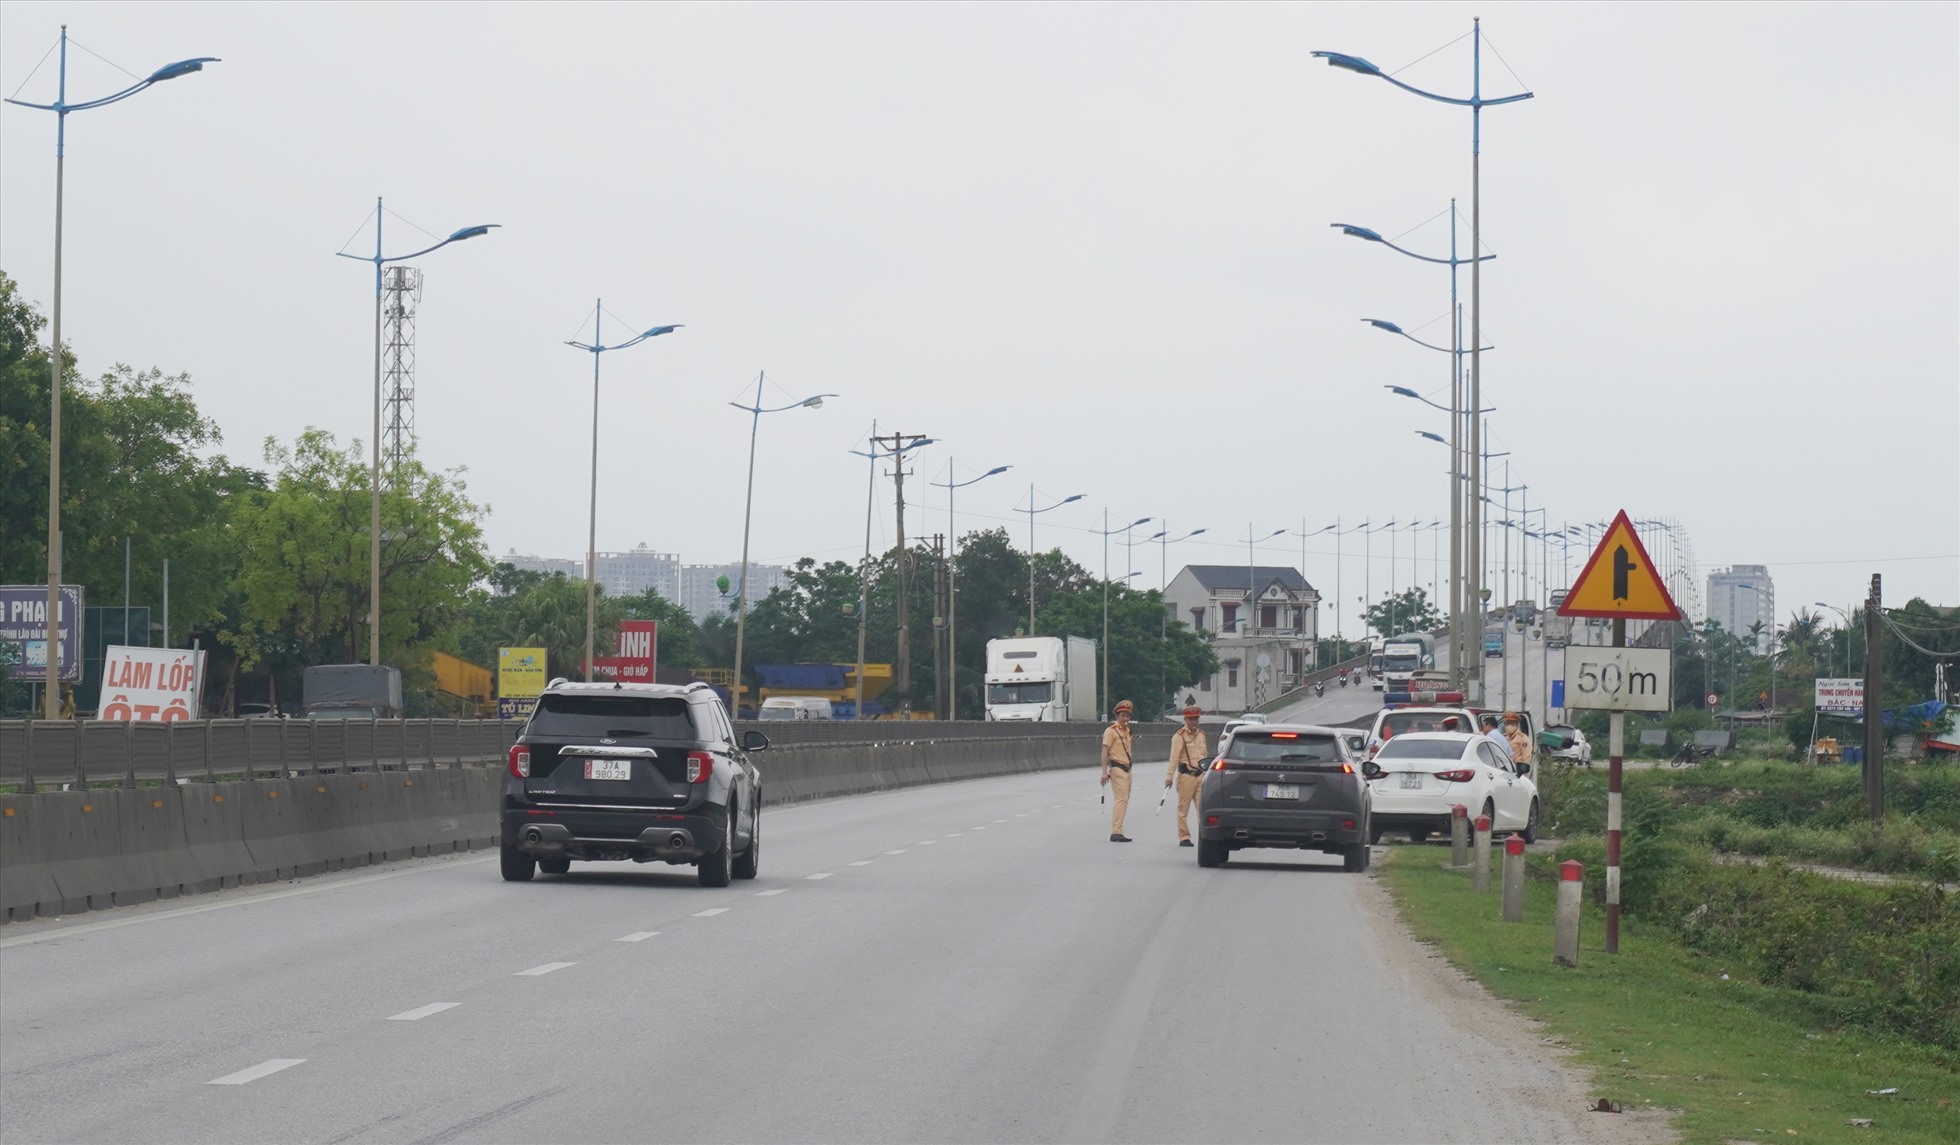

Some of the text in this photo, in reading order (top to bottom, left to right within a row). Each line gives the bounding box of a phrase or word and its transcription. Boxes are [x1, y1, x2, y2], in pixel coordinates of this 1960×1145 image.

[108, 655, 194, 692] LÀM LỐP
[517, 704, 535, 713] LIN
[602, 761, 620, 770] 37A
[595, 770, 626, 779] 980.29
